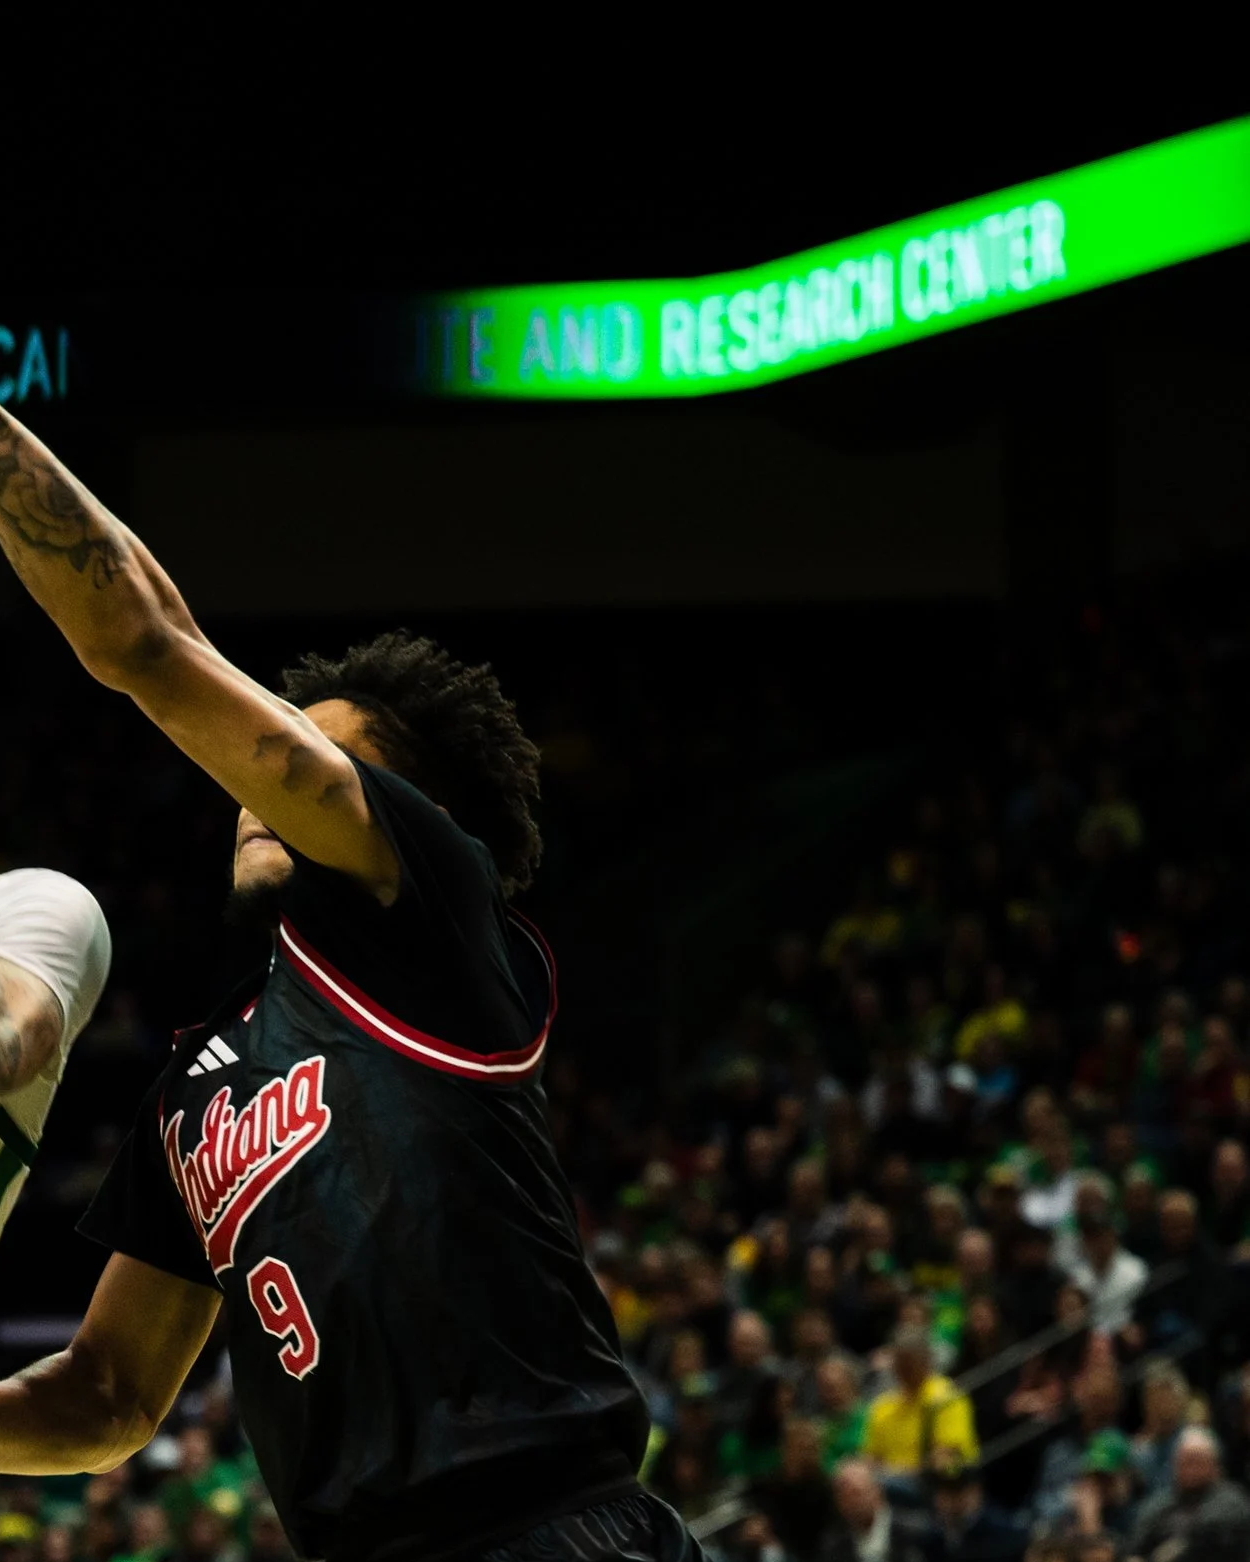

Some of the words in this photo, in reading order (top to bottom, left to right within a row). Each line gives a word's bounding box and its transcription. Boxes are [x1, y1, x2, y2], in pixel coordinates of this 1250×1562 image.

[519, 303, 644, 385] AND
[661, 251, 895, 377] RESEARCH
[899, 199, 1067, 322] CENTER
[163, 1055, 332, 1262] Indiana
[246, 1256, 320, 1381] 9
